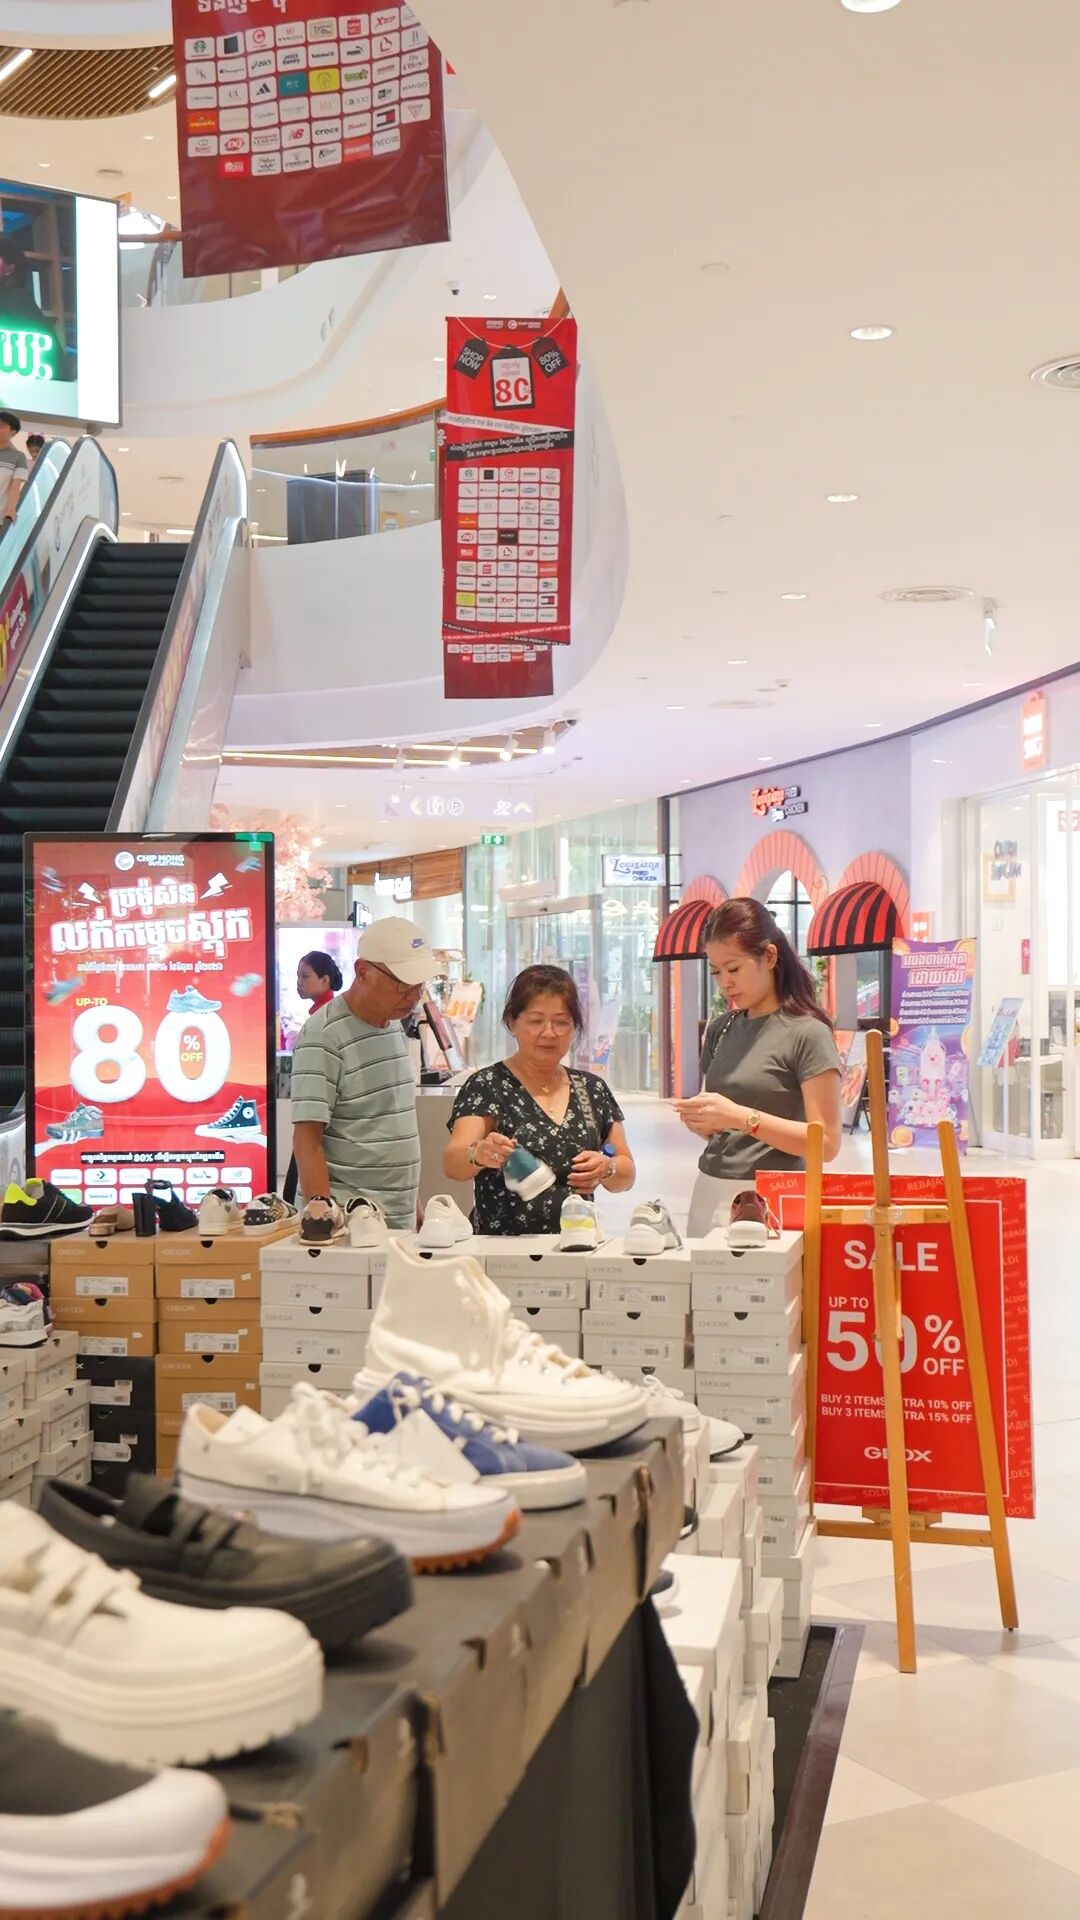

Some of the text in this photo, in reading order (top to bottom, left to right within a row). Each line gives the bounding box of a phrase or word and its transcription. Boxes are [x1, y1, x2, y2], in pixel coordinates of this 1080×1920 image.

[463, 347, 484, 361] SHOP
[539, 350, 560, 365] 80%
[458, 355, 481, 370] NOW
[545, 358, 562, 372] OFF
[136, 854, 185, 862] CHIP MONG
[609, 858, 660, 874] Louisiana
[76, 998, 108, 1007] UP-TO
[183, 1035, 201, 1051] %
[70, 1005, 231, 1104] 80
[181, 1052, 204, 1062] OFF
[569, 1074, 597, 1129] LACOSTE
[769, 1179, 799, 1192] SALDI
[162, 1248, 192, 1256] GEOX
[844, 1240, 939, 1271] SLE
[828, 1296, 869, 1309] UP TO
[924, 1314, 961, 1354] %
[923, 1357, 965, 1376] OFF
[821, 1393, 973, 1411] BUY 2 ITEMS TRA 10% OFF
[821, 1406, 973, 1424] BUY 3 ITEMS TRA 15% OFF
